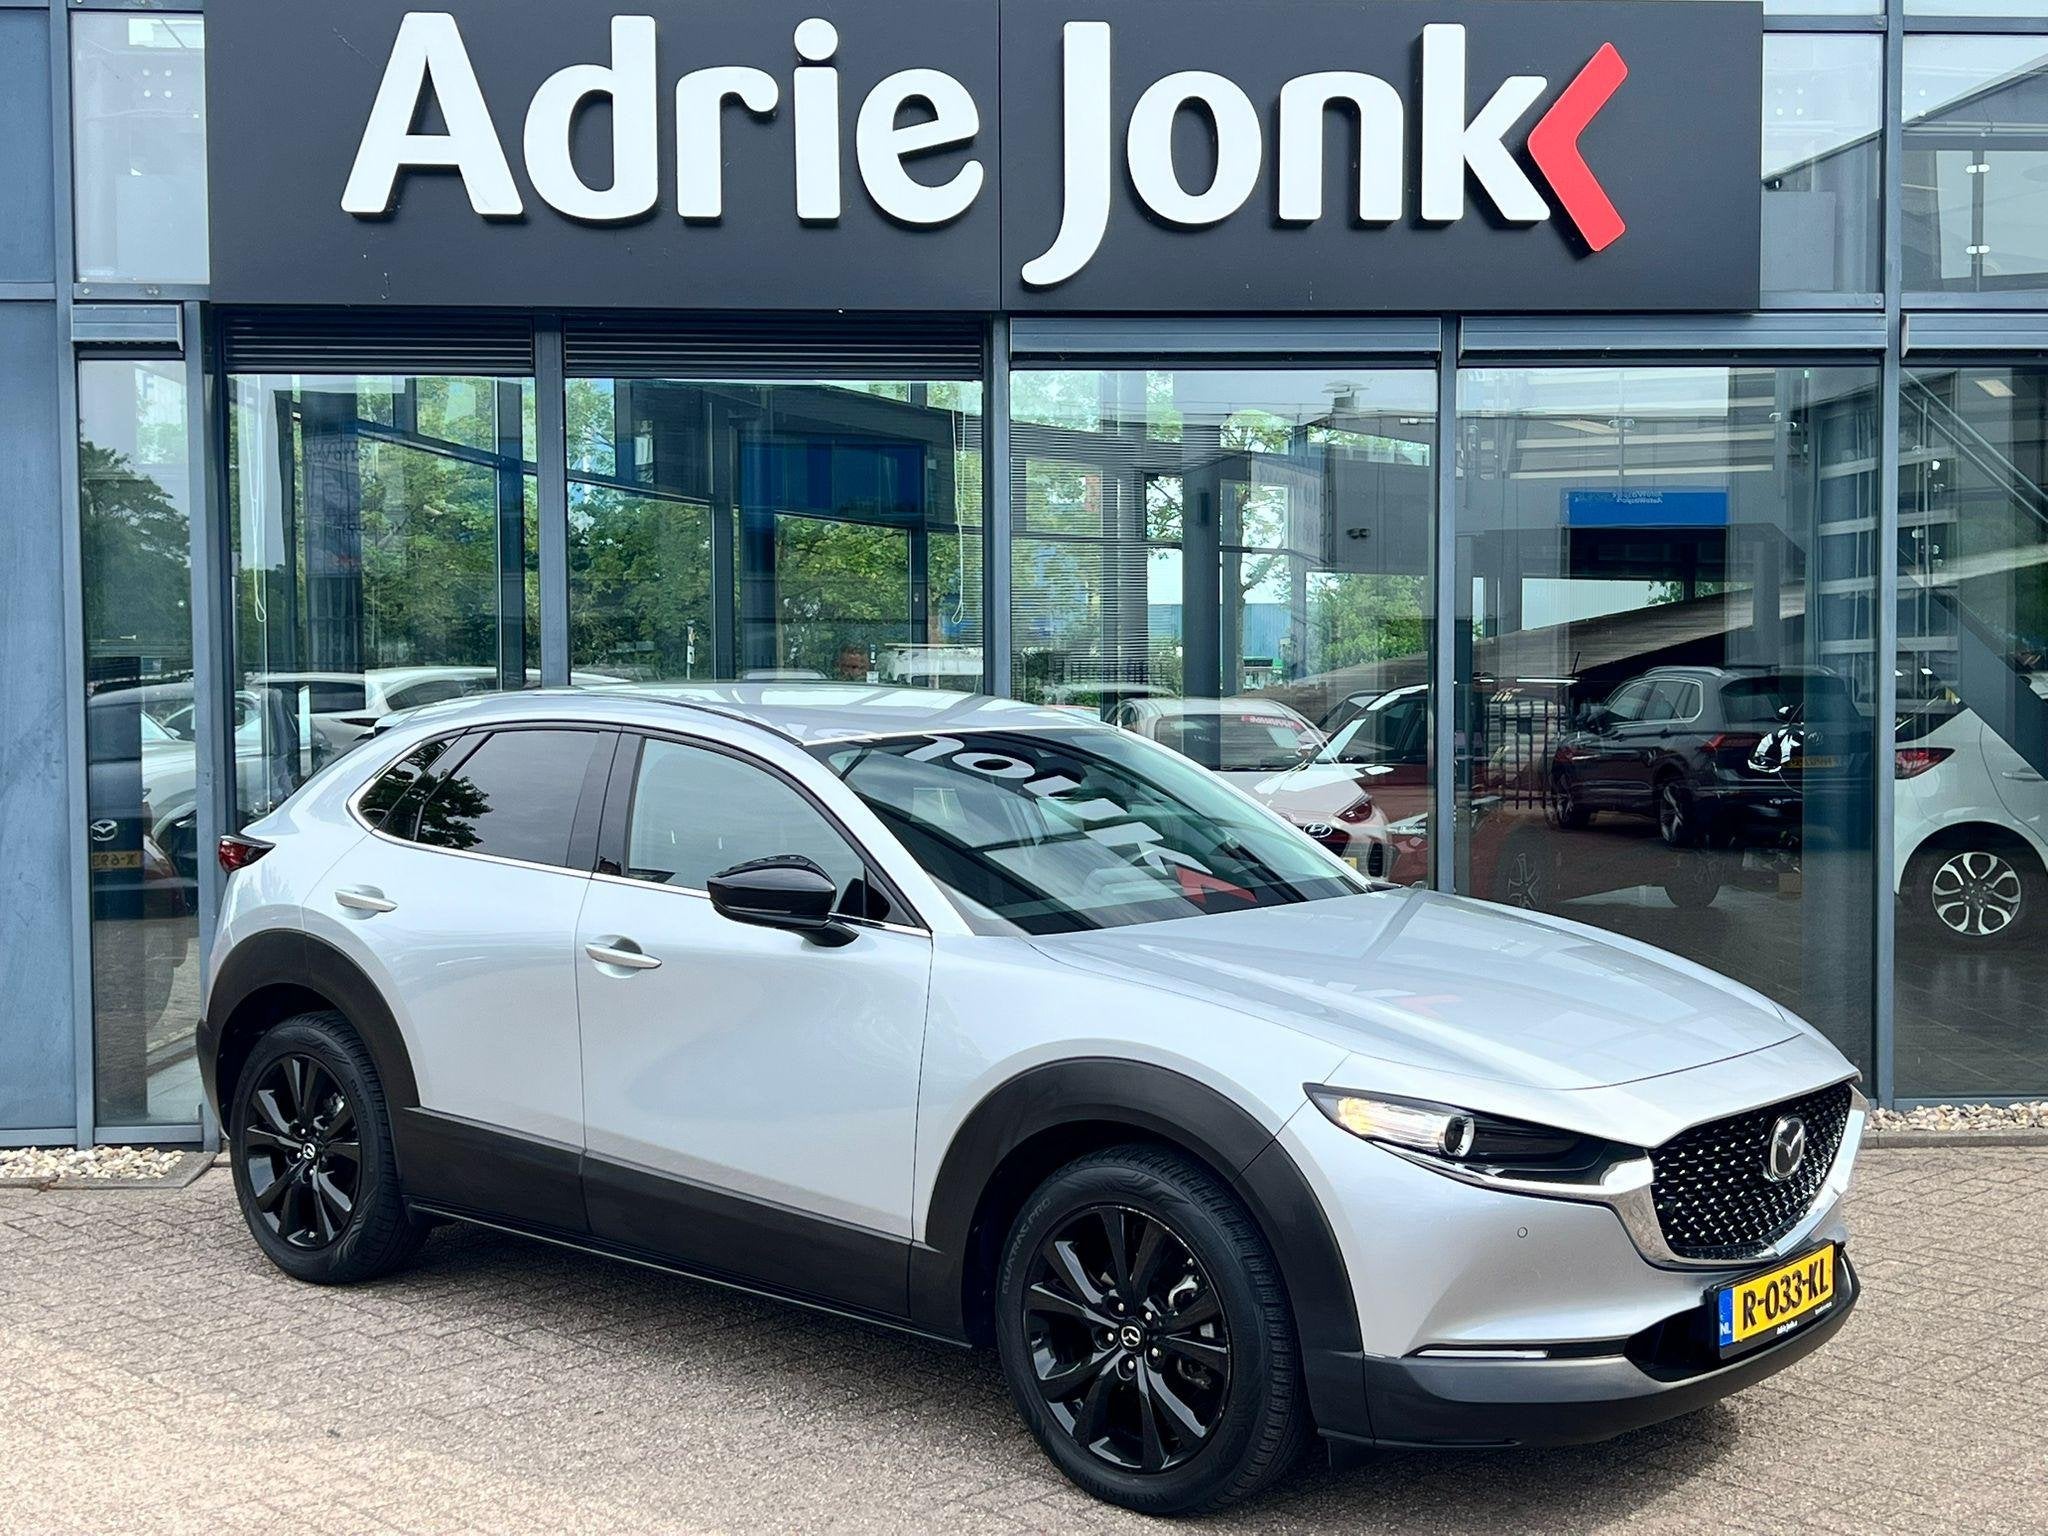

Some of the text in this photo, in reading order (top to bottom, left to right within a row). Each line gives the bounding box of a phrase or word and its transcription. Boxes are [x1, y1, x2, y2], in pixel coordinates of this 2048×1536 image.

[341, 11, 1551, 286] Adrie Jonk
[1027, 1198, 1051, 1224] PRO
[1742, 1258, 1829, 1331] R-033-KL
[1720, 1321, 1732, 1336] NL
